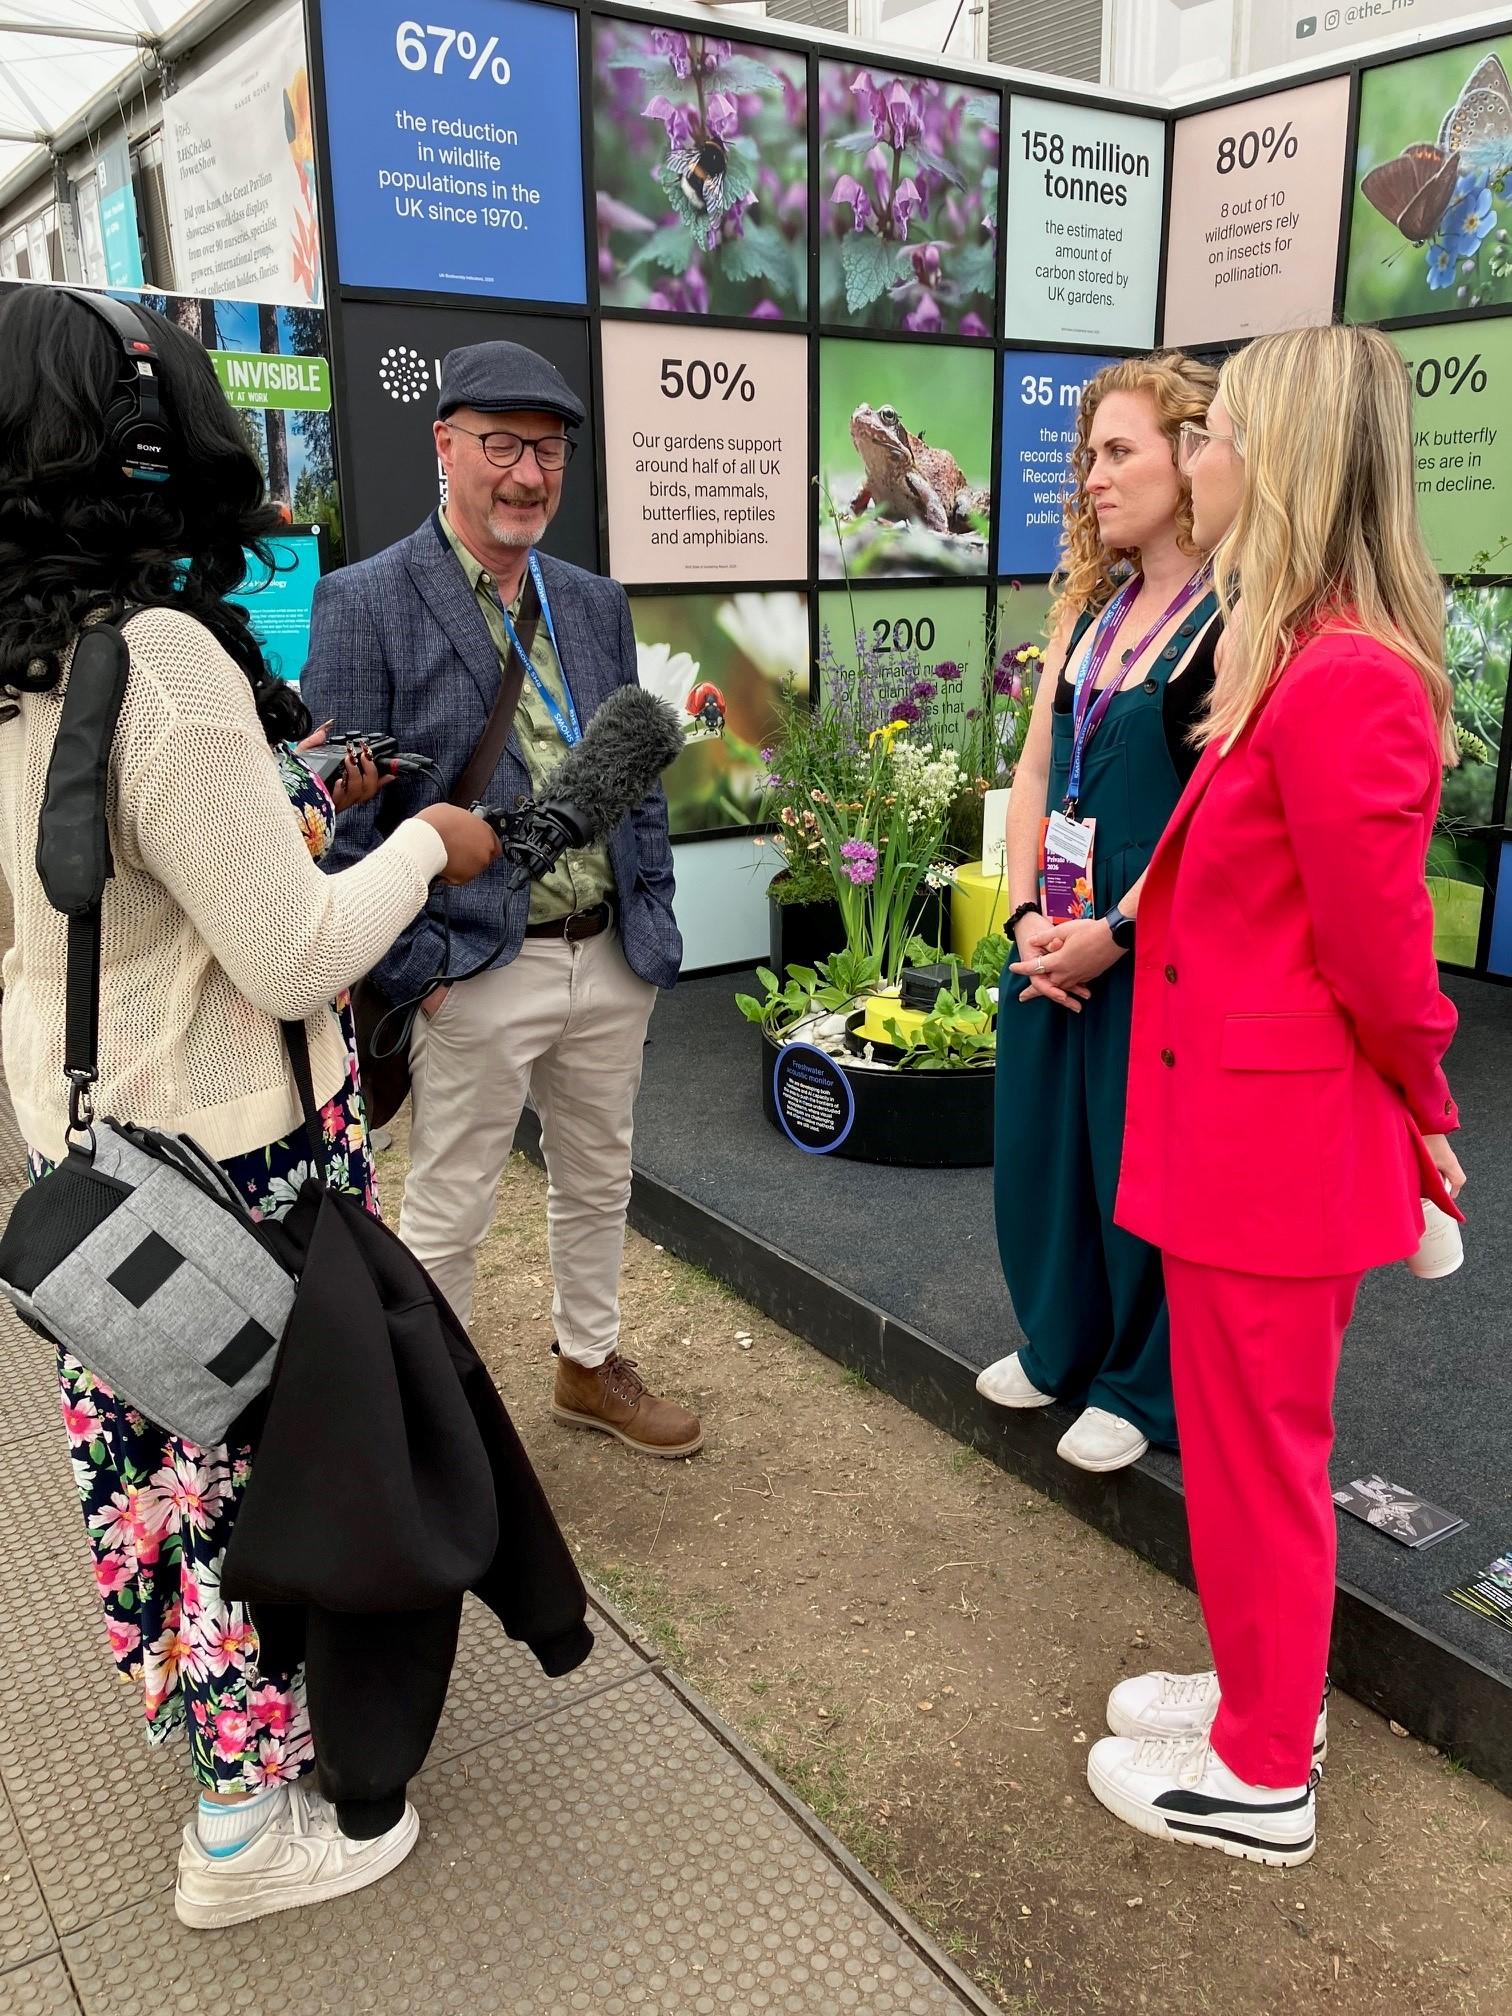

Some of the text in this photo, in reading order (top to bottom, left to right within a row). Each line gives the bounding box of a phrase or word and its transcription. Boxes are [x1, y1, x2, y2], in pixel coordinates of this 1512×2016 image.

[396, 20, 511, 85] 67%
[395, 110, 518, 146] the reduction
[418, 141, 501, 171] in wildlife
[1021, 129, 1150, 177] 158 million
[1216, 121, 1298, 175] 80%
[184, 205, 194, 220] Did
[194, 204, 206, 219] you
[222, 191, 233, 204] the
[233, 184, 249, 200] Great
[249, 172, 273, 193] Pavilion
[379, 169, 541, 204] populations in the
[1044, 168, 1128, 206] tonnes
[395, 196, 528, 231] UK since 1970.
[1220, 190, 1285, 218] 8 out of 10
[186, 198, 269, 241] showcases displays
[1046, 219, 1123, 242] the estimated
[1205, 211, 1300, 243] wildflowers rely
[188, 247, 202, 261] from
[202, 244, 215, 256] over
[215, 238, 224, 252] 90
[250, 216, 278, 241] specialist
[1208, 236, 1293, 264] on insects for
[215, 249, 253, 273] international
[1055, 245, 1112, 262] amount of
[208, 278, 236, 296] collection
[259, 264, 279, 280] florists
[1035, 265, 1129, 289] carbon stored by
[1214, 262, 1282, 288] pollination.
[1048, 286, 1115, 306] UK gardens.
[226, 359, 321, 392] INVISIBLE
[660, 358, 755, 402] 50%
[1404, 353, 1488, 398] 0%
[236, 391, 246, 402] AT
[247, 392, 269, 403] WORK
[1021, 375, 1053, 406] 35
[136, 443, 162, 453] SONY
[632, 431, 782, 454] Our gardens support
[1040, 428, 1058, 442] the
[1433, 426, 1498, 446] butterfly
[635, 457, 781, 475] around half of all UK
[1020, 450, 1063, 463] records
[1439, 455, 1464, 470] are
[1468, 451, 1482, 467] in
[1022, 468, 1066, 483] iRecord
[1435, 476, 1496, 493] decline.
[649, 481, 769, 500] birds, mammals,
[642, 505, 776, 524] butterflies, reptiles
[1026, 510, 1060, 527] public
[651, 529, 769, 547] and amphibians.
[528, 555, 548, 603] RHS SHOWS
[872, 617, 936, 653] 200
[514, 640, 543, 689] RHS SHOWS
[940, 680, 963, 694] and
[942, 702, 965, 714] that
[553, 712, 574, 743] SHOWS
[786, 1066, 834, 1087] acoustic monitor
[792, 1060, 825, 1076] Freshwater
